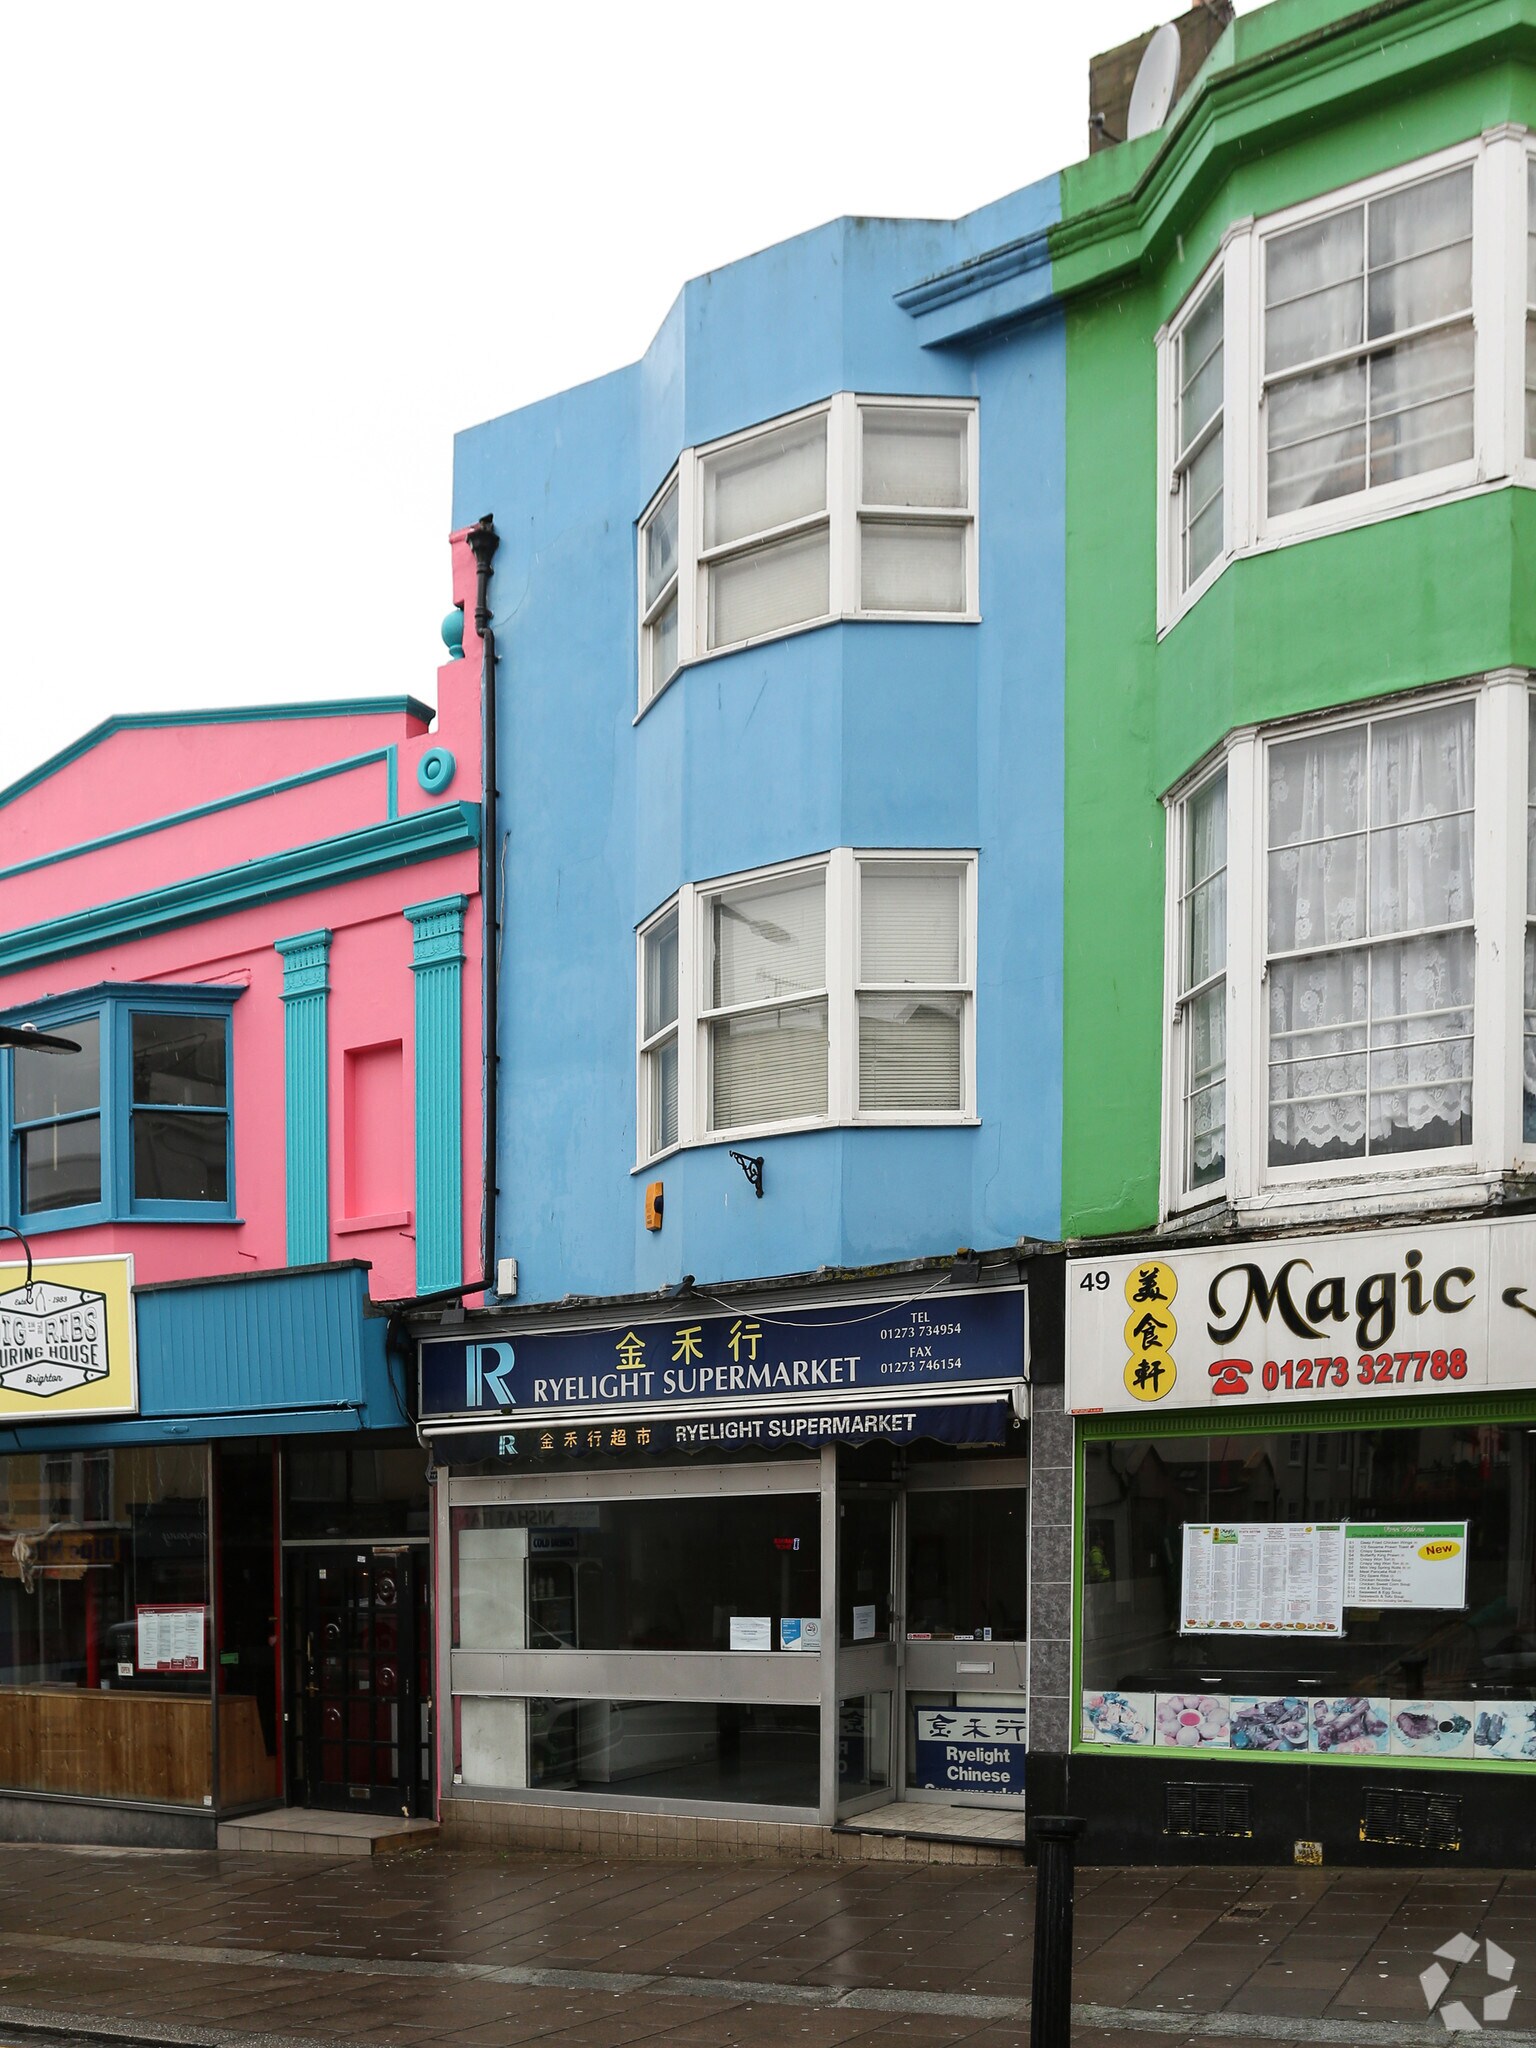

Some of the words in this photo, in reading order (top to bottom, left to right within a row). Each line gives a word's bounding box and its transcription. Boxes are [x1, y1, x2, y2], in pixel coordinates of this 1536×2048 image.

[1079, 1270, 1111, 1292] 49
[1206, 1249, 1477, 1351] Magic
[45, 1306, 98, 1345] RIBS
[910, 1311, 931, 1324] TEL
[880, 1327, 916, 1341] 01273
[918, 1322, 962, 1338] 734954
[49, 1343, 99, 1367] HOUSE
[615, 1319, 763, 1372] 金禾行
[909, 1345, 932, 1358] FAX
[880, 1360, 916, 1375] 01273
[918, 1357, 962, 1372] 746154
[1261, 1354, 1351, 1391] 01273
[1356, 1347, 1469, 1386] 327788
[25, 1373, 63, 1386] Brighton
[533, 1371, 655, 1403] RYELIGHT
[663, 1355, 861, 1395] SUPERMARKET
[539, 1427, 652, 1451] 金禾行超市
[675, 1420, 763, 1443] RYELIGHT
[768, 1413, 917, 1438] SUPERMARKET
[1426, 1544, 1453, 1556] New
[946, 1745, 1011, 1765] Ryelight
[946, 1765, 1011, 1783] Chinese
